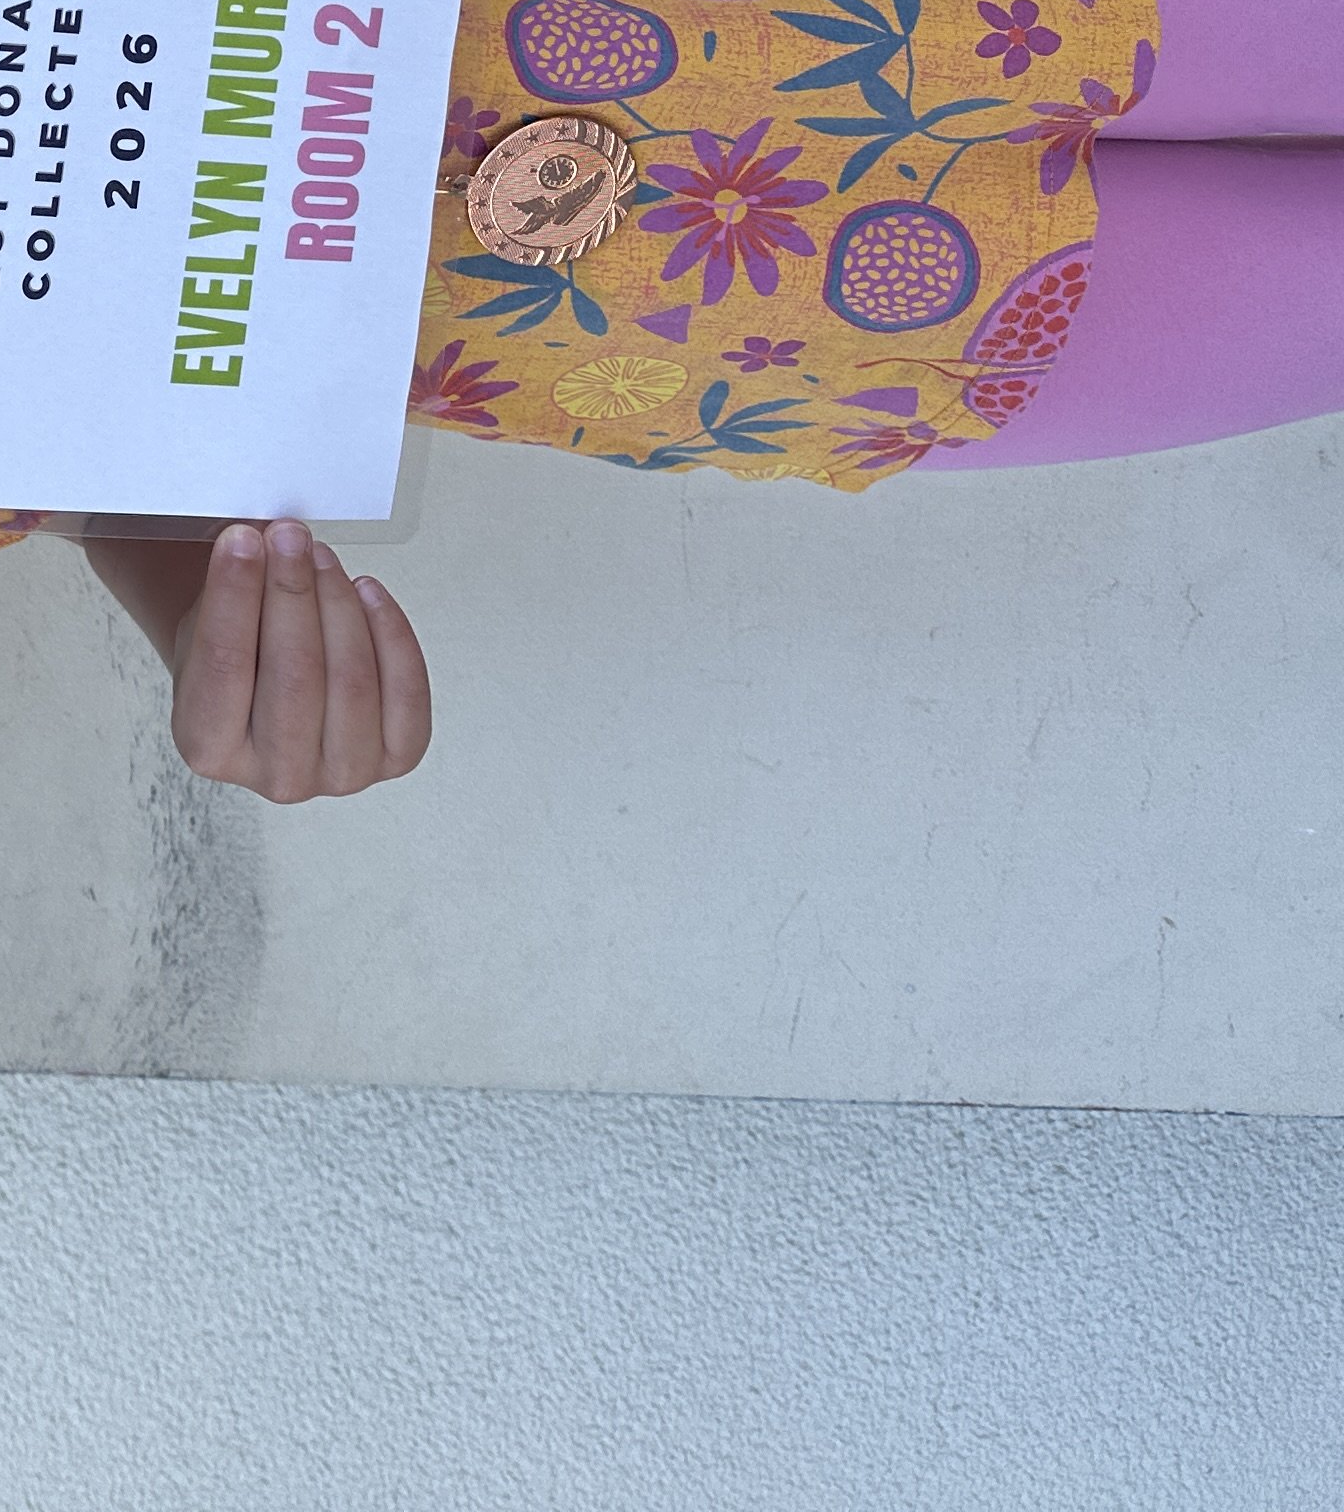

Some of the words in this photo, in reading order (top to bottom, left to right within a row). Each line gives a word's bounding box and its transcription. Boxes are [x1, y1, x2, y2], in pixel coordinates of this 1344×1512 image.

[313, 3, 384, 49] 2
[103, 33, 158, 210] 2026
[284, 70, 375, 263] ROOM
[169, 160, 268, 387] EVELYN
